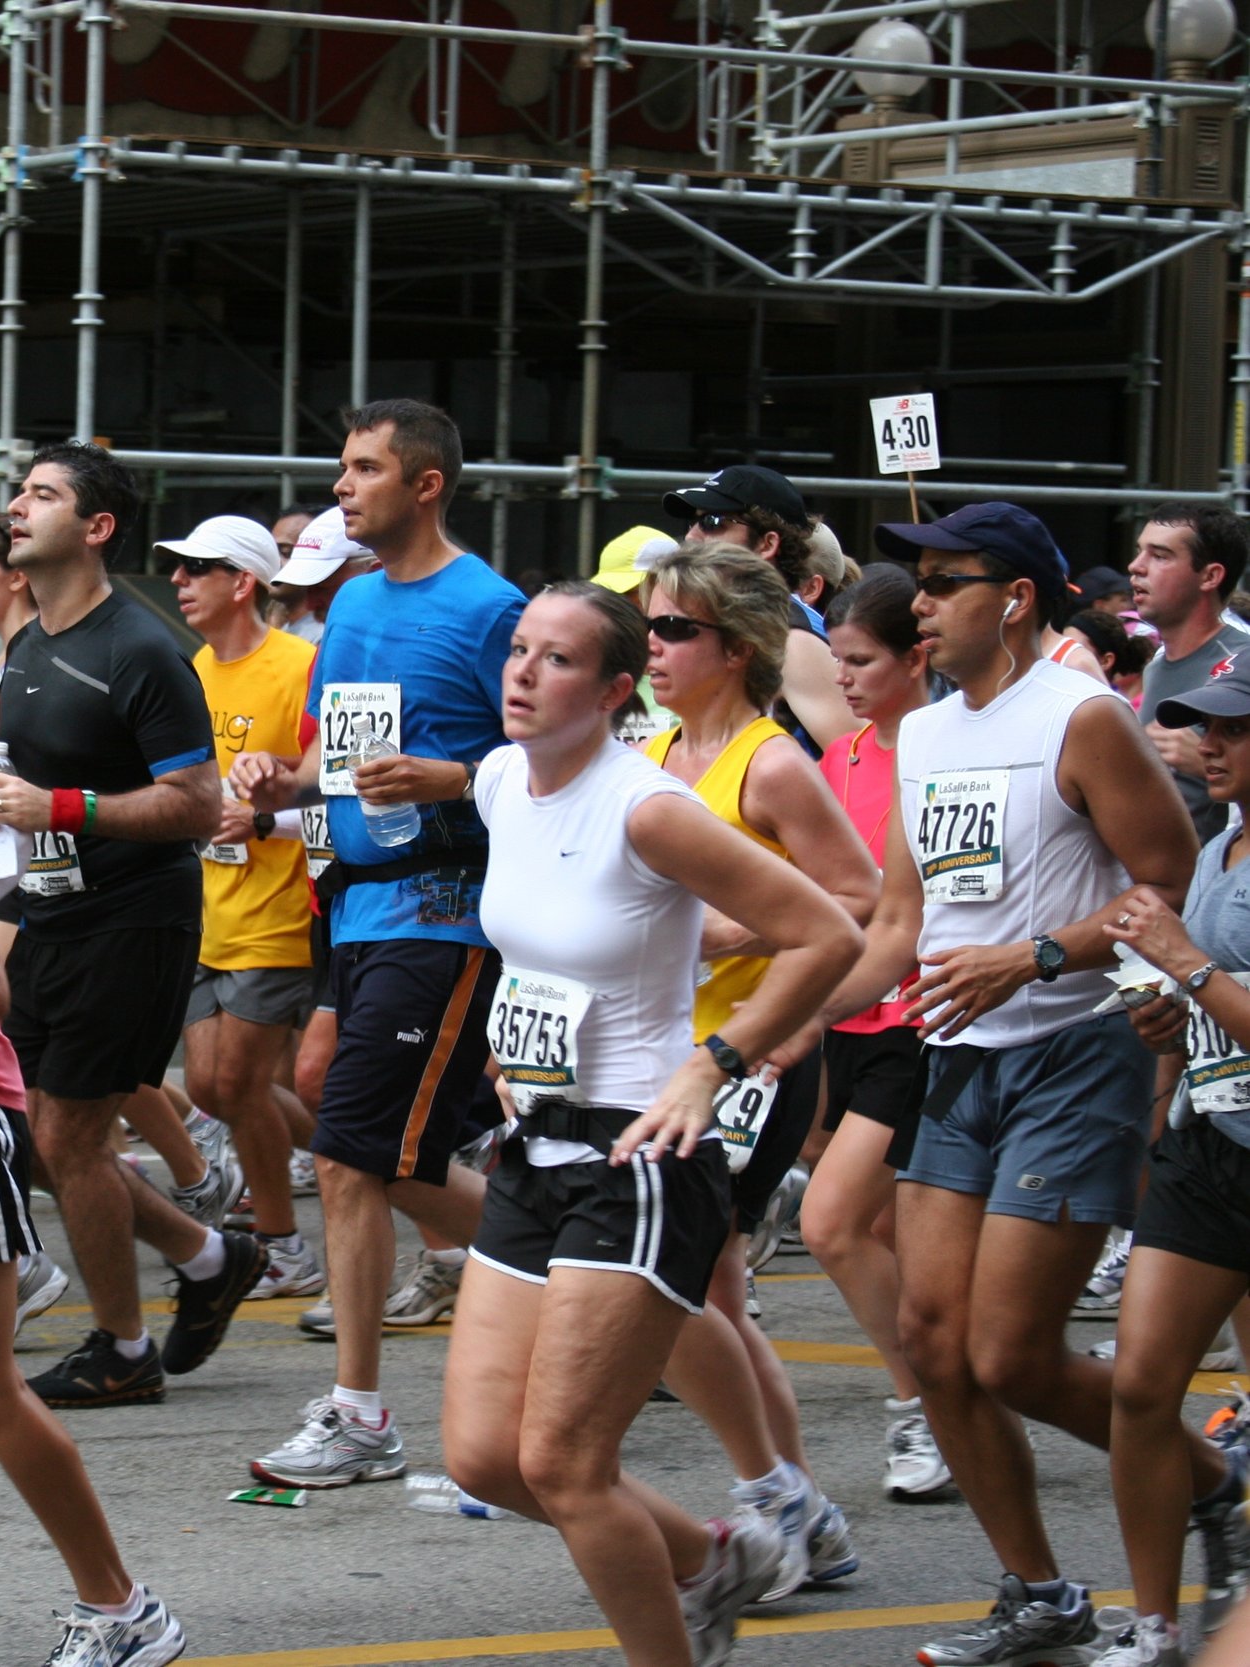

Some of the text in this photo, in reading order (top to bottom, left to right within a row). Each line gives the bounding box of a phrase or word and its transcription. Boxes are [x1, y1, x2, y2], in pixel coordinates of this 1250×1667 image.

[882, 415, 931, 451] 4:30
[368, 692, 386, 702] Bank
[325, 711, 393, 752] 122
[939, 781, 991, 794] LaSalle Bank
[918, 802, 996, 854] 47726
[939, 851, 993, 871] ANNIVERSARY
[492, 1002, 568, 1069] 35753
